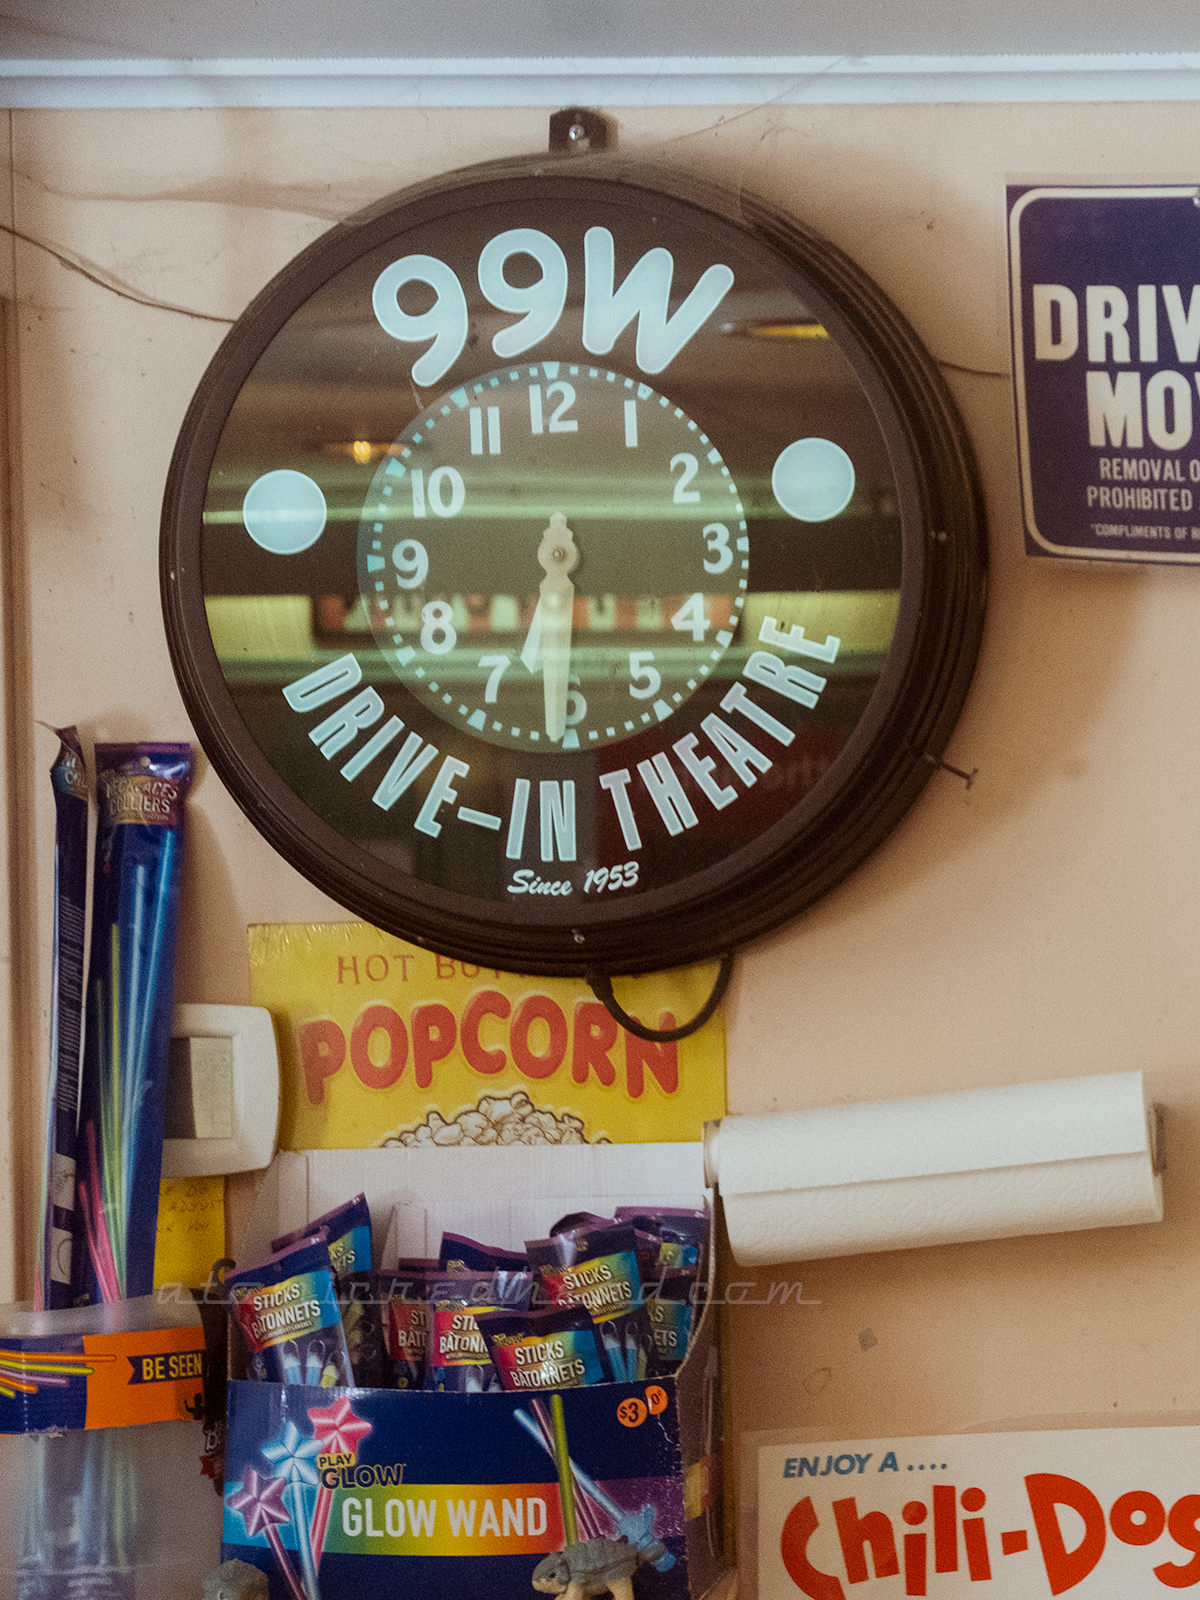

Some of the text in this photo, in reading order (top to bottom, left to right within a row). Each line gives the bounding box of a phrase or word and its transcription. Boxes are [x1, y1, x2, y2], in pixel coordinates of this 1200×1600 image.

[372, 226, 735, 387] 99W
[529, 381, 578, 434] 12
[624, 400, 638, 447] 1
[470, 406, 500, 455] 11
[670, 453, 700, 503] 2
[1100, 457, 1186, 482] REMOVAL
[411, 466, 465, 518] 10
[1087, 485, 1193, 511] PROHIBITED
[703, 523, 733, 574] 3
[1174, 527, 1188, 539] OF
[392, 539, 429, 589] 9
[420, 601, 457, 655] 8
[670, 593, 711, 641] 4
[478, 655, 511, 703] 7
[629, 651, 661, 699] 5
[282, 615, 842, 862] DRIVE-IN THEATRE
[507, 861, 641, 896] Since 1953
[337, 955, 414, 985] HOT
[300, 989, 679, 1106] POPCORN
[253, 1283, 301, 1311] STICKS
[563, 1264, 612, 1290] STICKS
[142, 1357, 166, 1380] BE
[515, 1340, 564, 1366] STICKS
[619, 1402, 640, 1422] $3
[319, 1454, 352, 1468] PLAY
[321, 1463, 404, 1490] GLOW
[782, 1453, 872, 1479] ENJOY
[342, 1496, 547, 1537] GLOW WAND
